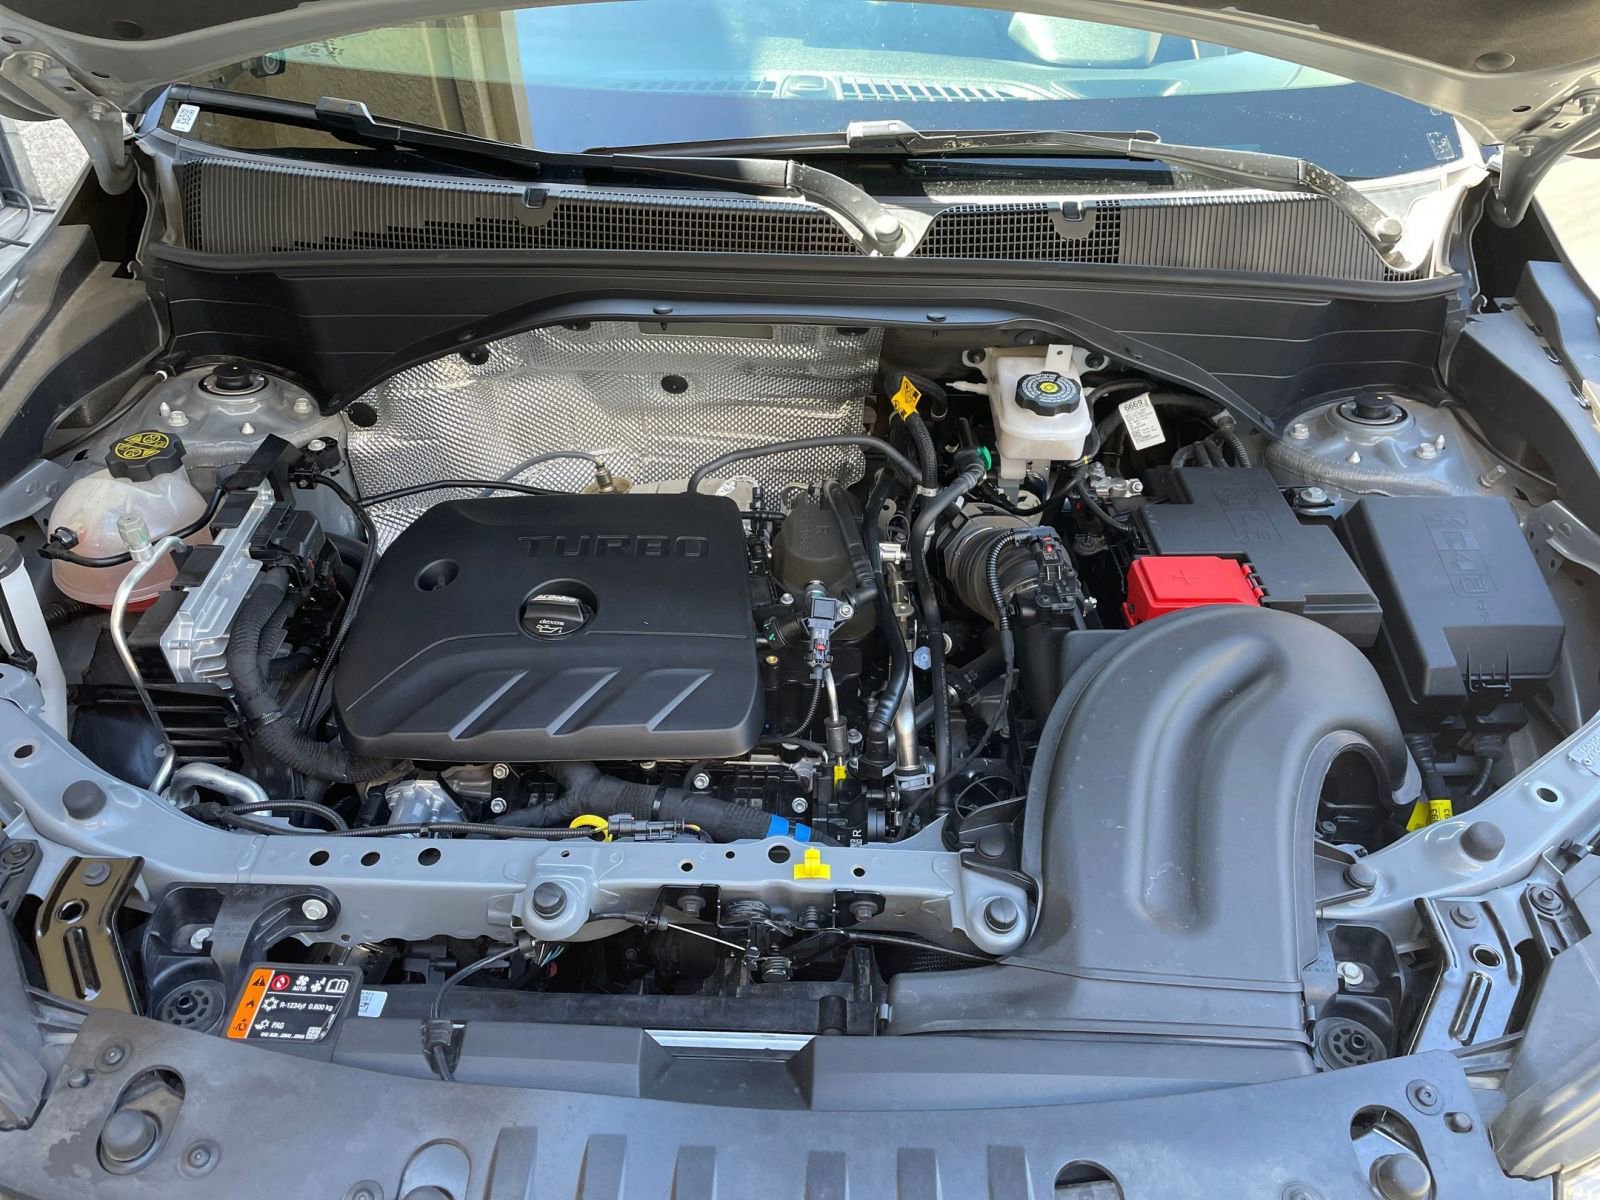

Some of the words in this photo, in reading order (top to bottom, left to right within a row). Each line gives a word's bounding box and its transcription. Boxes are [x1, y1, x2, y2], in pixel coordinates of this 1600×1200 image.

[518, 534, 710, 558] TURBO
[279, 1001, 307, 1010] R-1234yf
[271, 1022, 285, 1030] PAG
